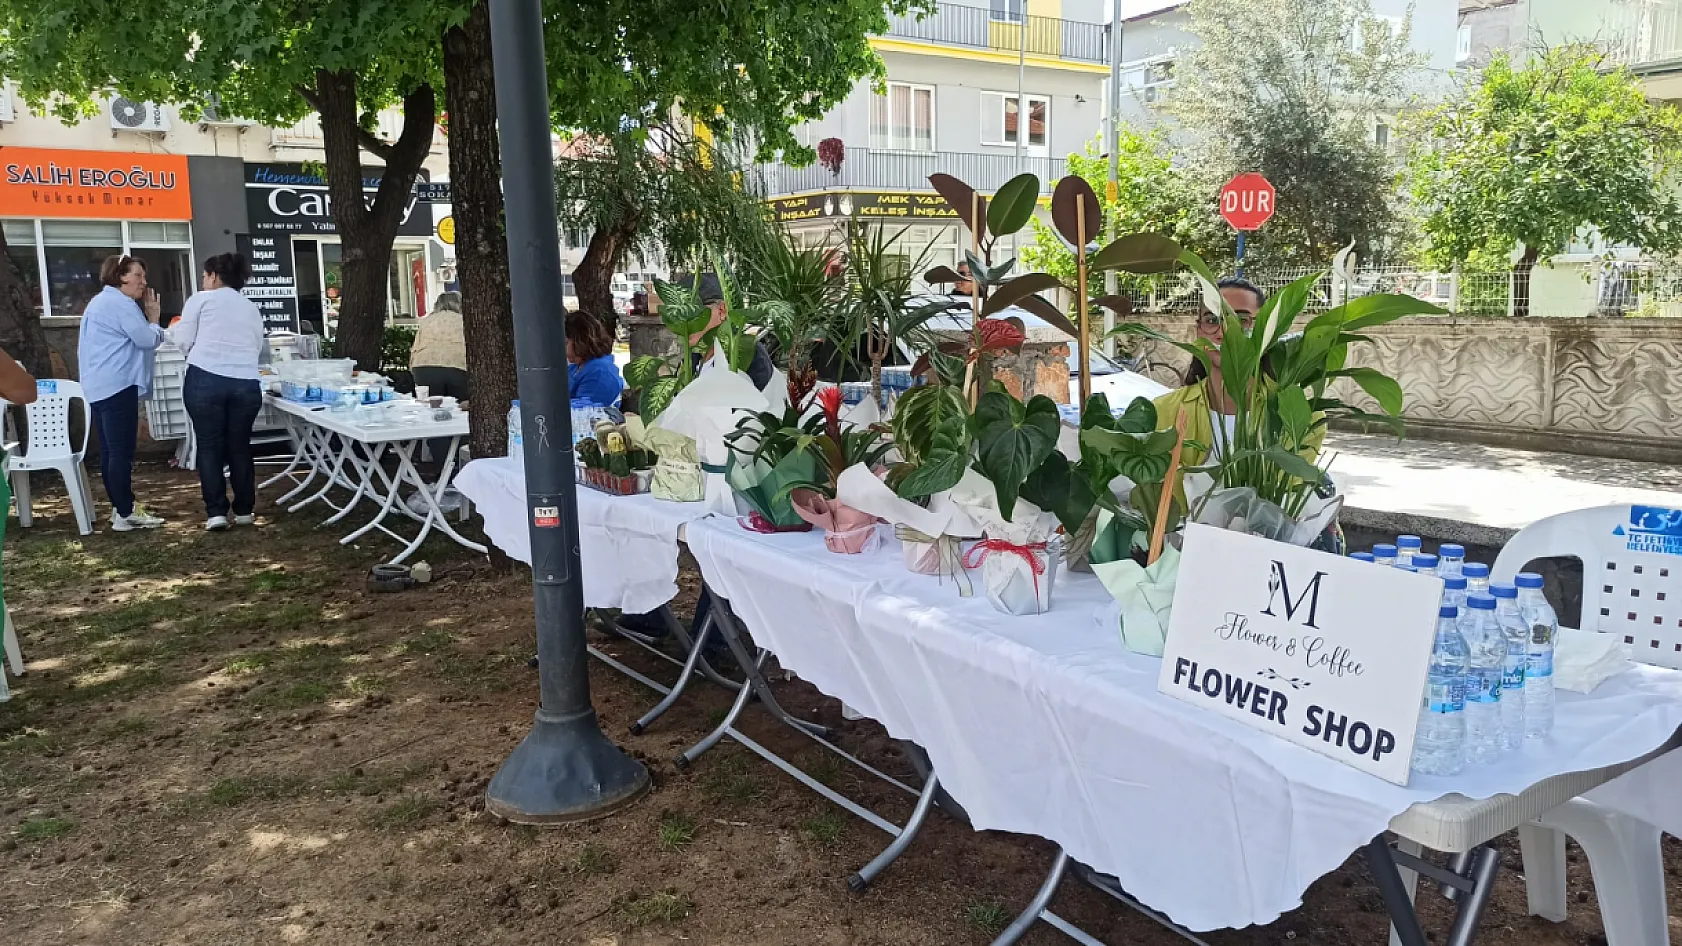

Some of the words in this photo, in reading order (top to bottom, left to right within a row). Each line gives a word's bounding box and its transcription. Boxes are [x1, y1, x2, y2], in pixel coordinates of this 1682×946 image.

[6, 161, 74, 186] SALİH
[79, 165, 176, 189] EROĞLU
[782, 198, 807, 208] YAPI
[877, 195, 910, 204] MEK
[913, 206, 959, 217] İNŞAA
[1225, 189, 1271, 213] DUR
[1260, 560, 1329, 630] M
[1214, 612, 1283, 652] Flower
[1286, 638, 1297, 657] &
[1302, 635, 1366, 677] Coffee
[1173, 657, 1289, 725] FLOWER
[1302, 704, 1396, 762] SHOP
